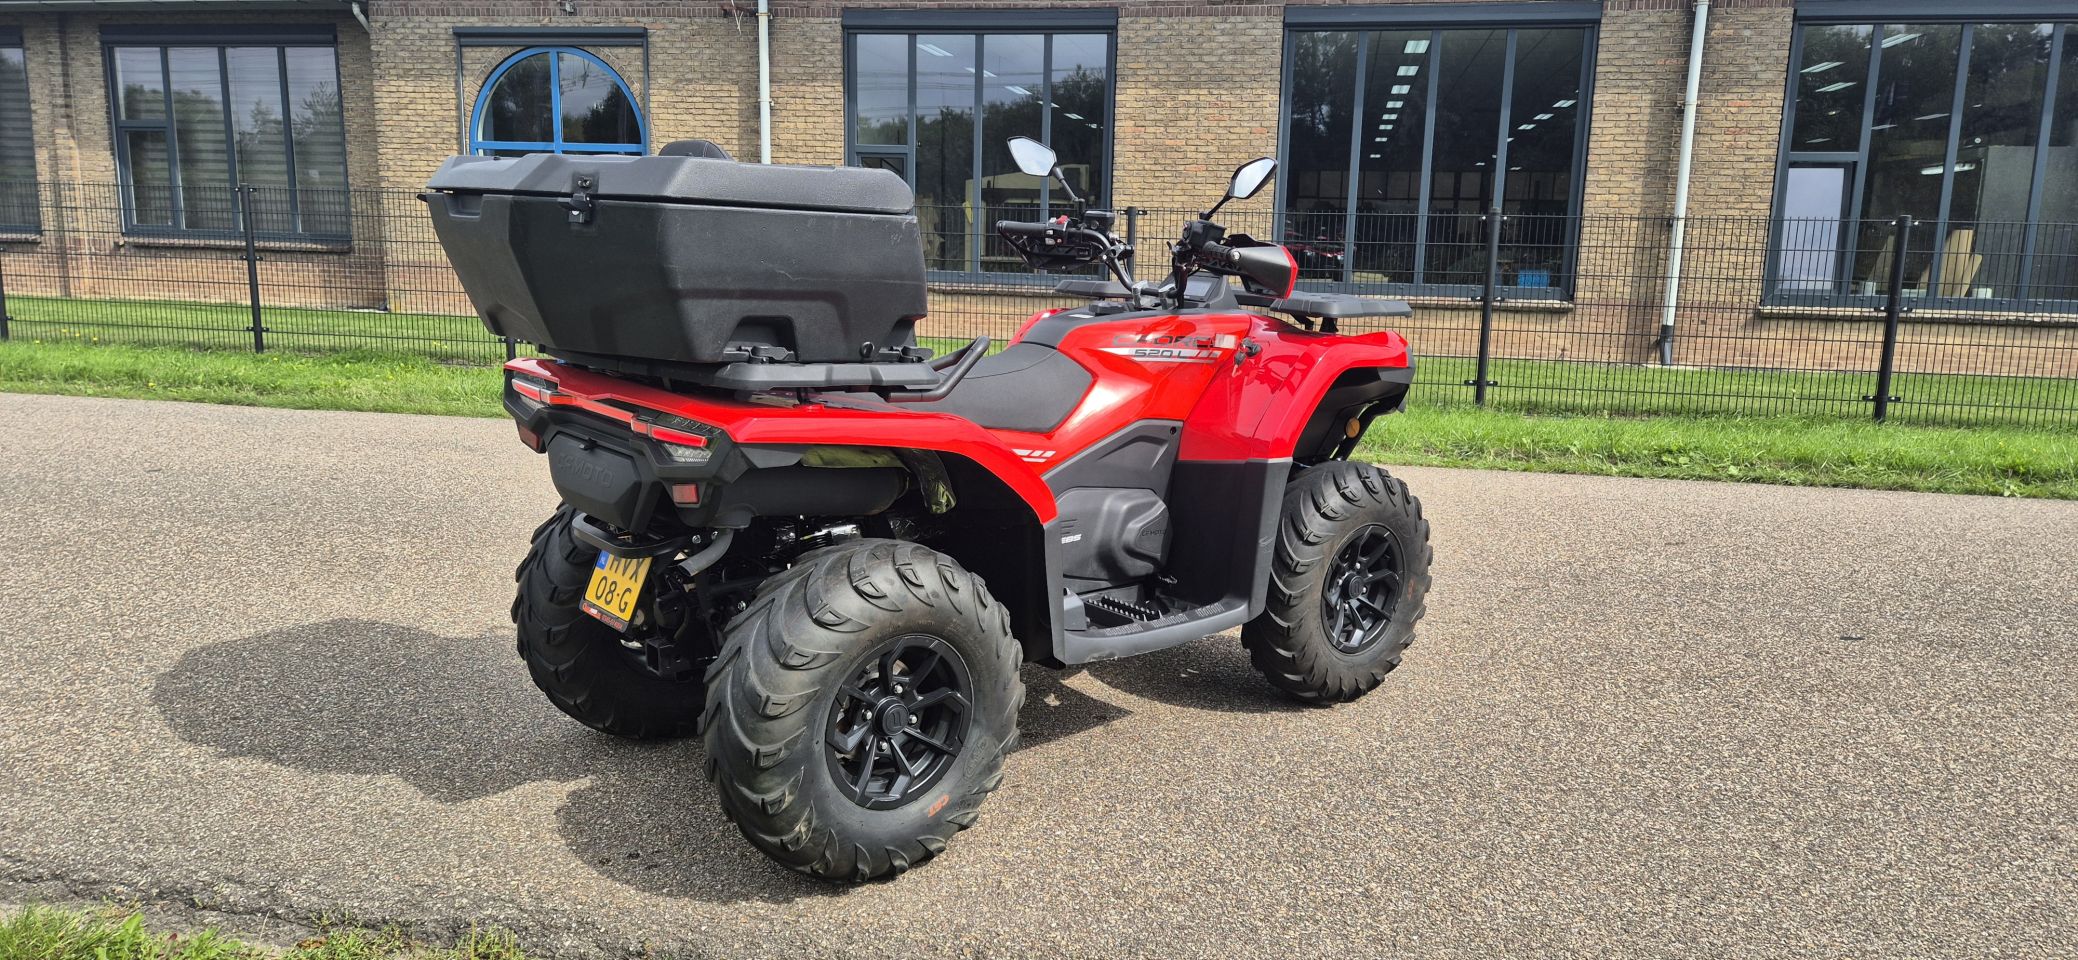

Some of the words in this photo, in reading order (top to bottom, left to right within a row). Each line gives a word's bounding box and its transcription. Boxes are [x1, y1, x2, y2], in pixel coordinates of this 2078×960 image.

[1112, 334, 1236, 349] CORC
[1134, 349, 1172, 358] 520
[609, 556, 646, 583] HVX
